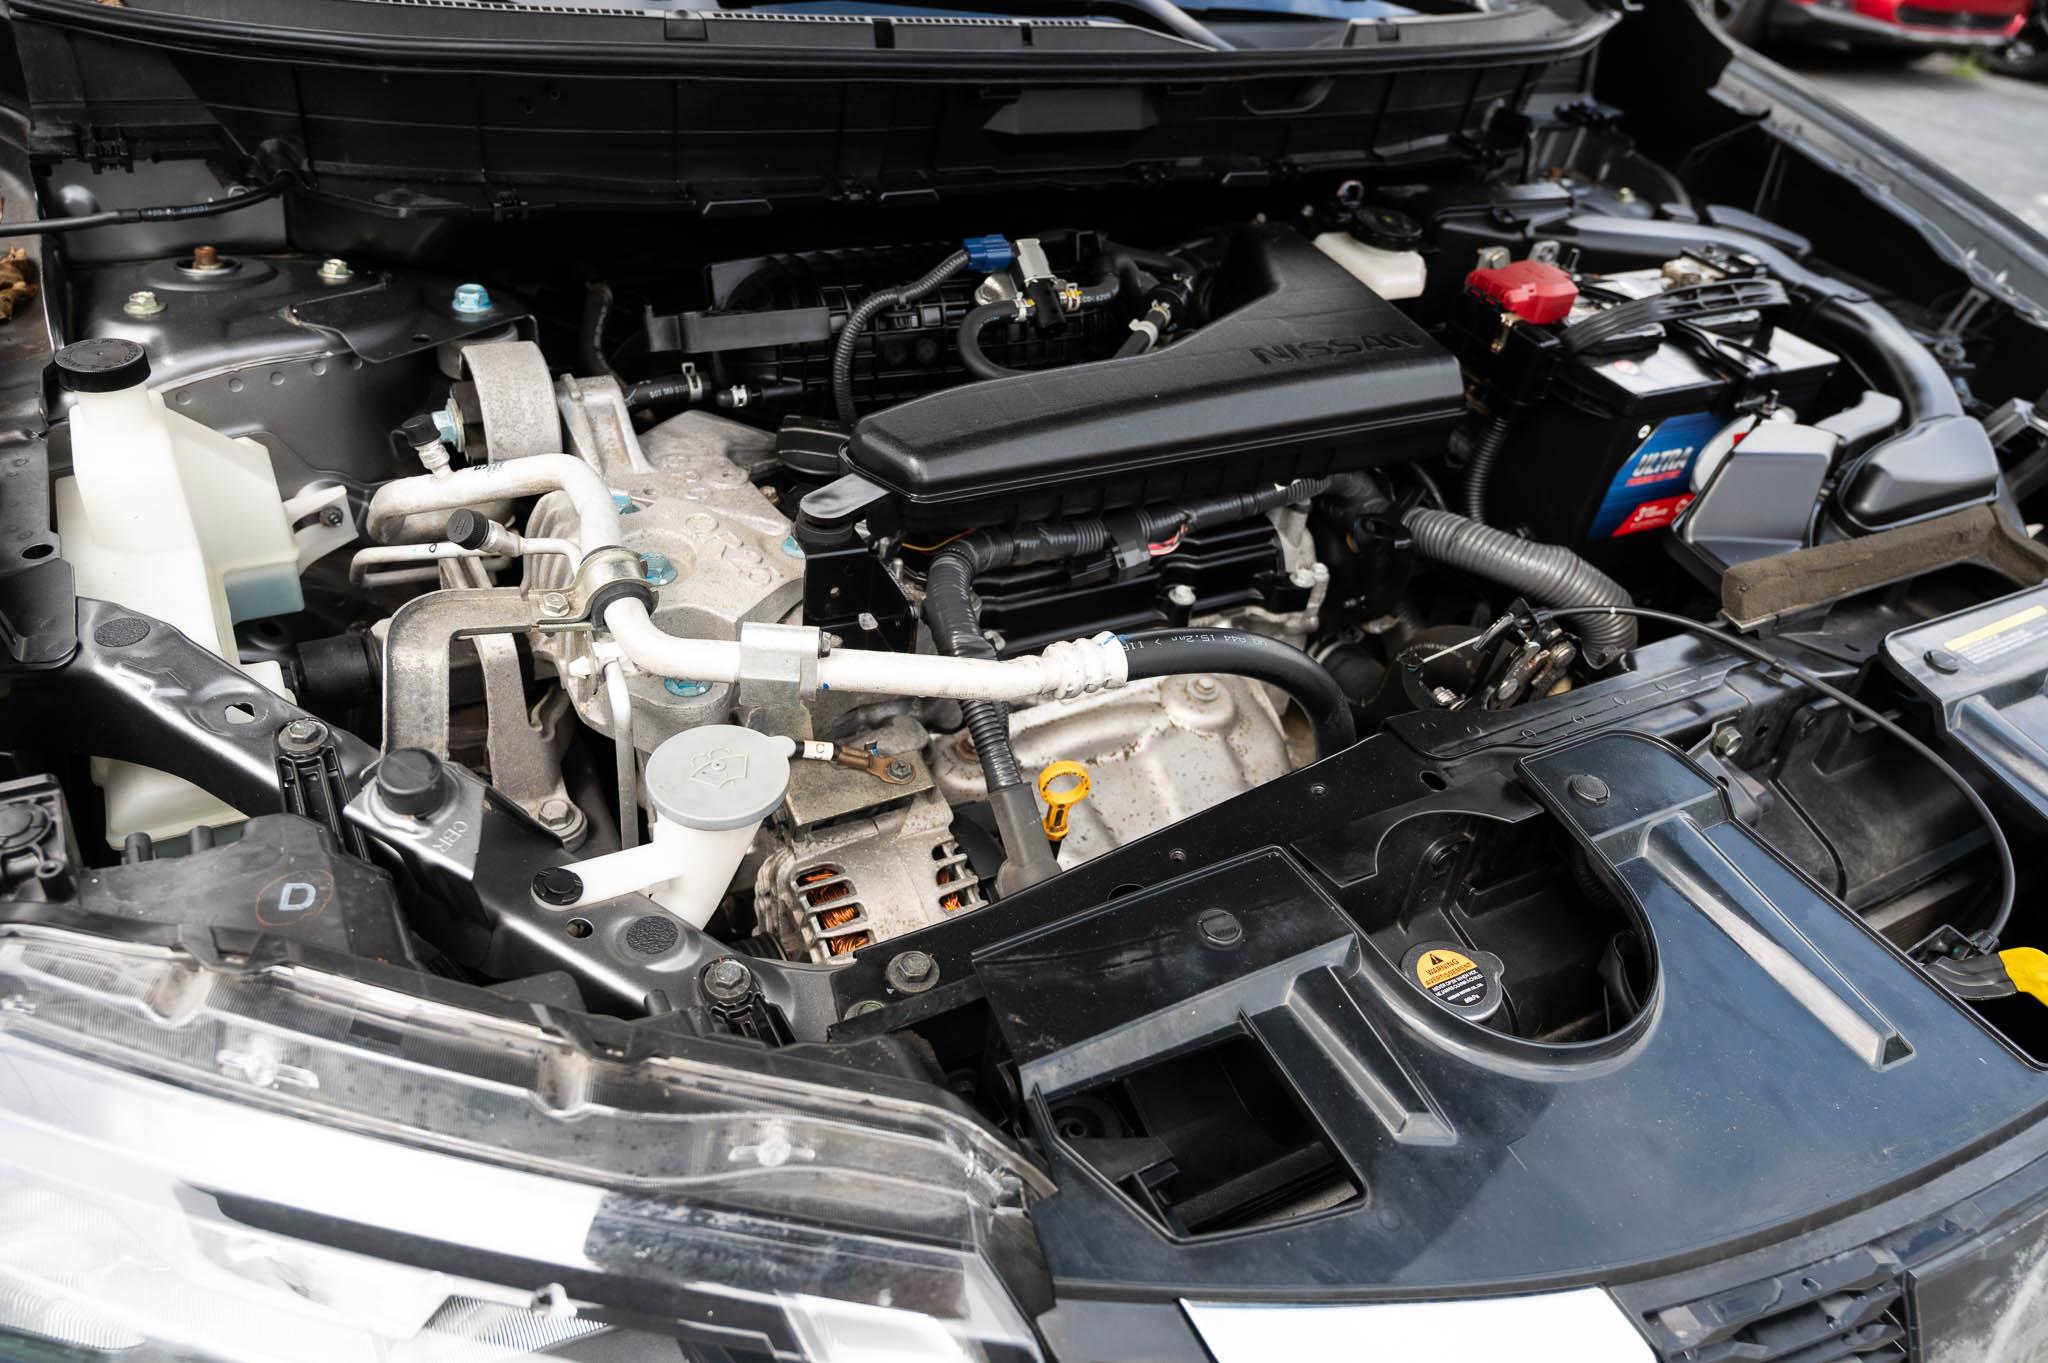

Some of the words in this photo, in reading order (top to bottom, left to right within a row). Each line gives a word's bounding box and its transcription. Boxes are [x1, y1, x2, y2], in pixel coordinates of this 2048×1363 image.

[1250, 335, 1424, 365] NISSAN
[1632, 446, 1694, 477] ULTRA
[432, 820, 468, 853] CBR
[278, 882, 317, 911] D
[1426, 958, 1459, 975] WARNING
